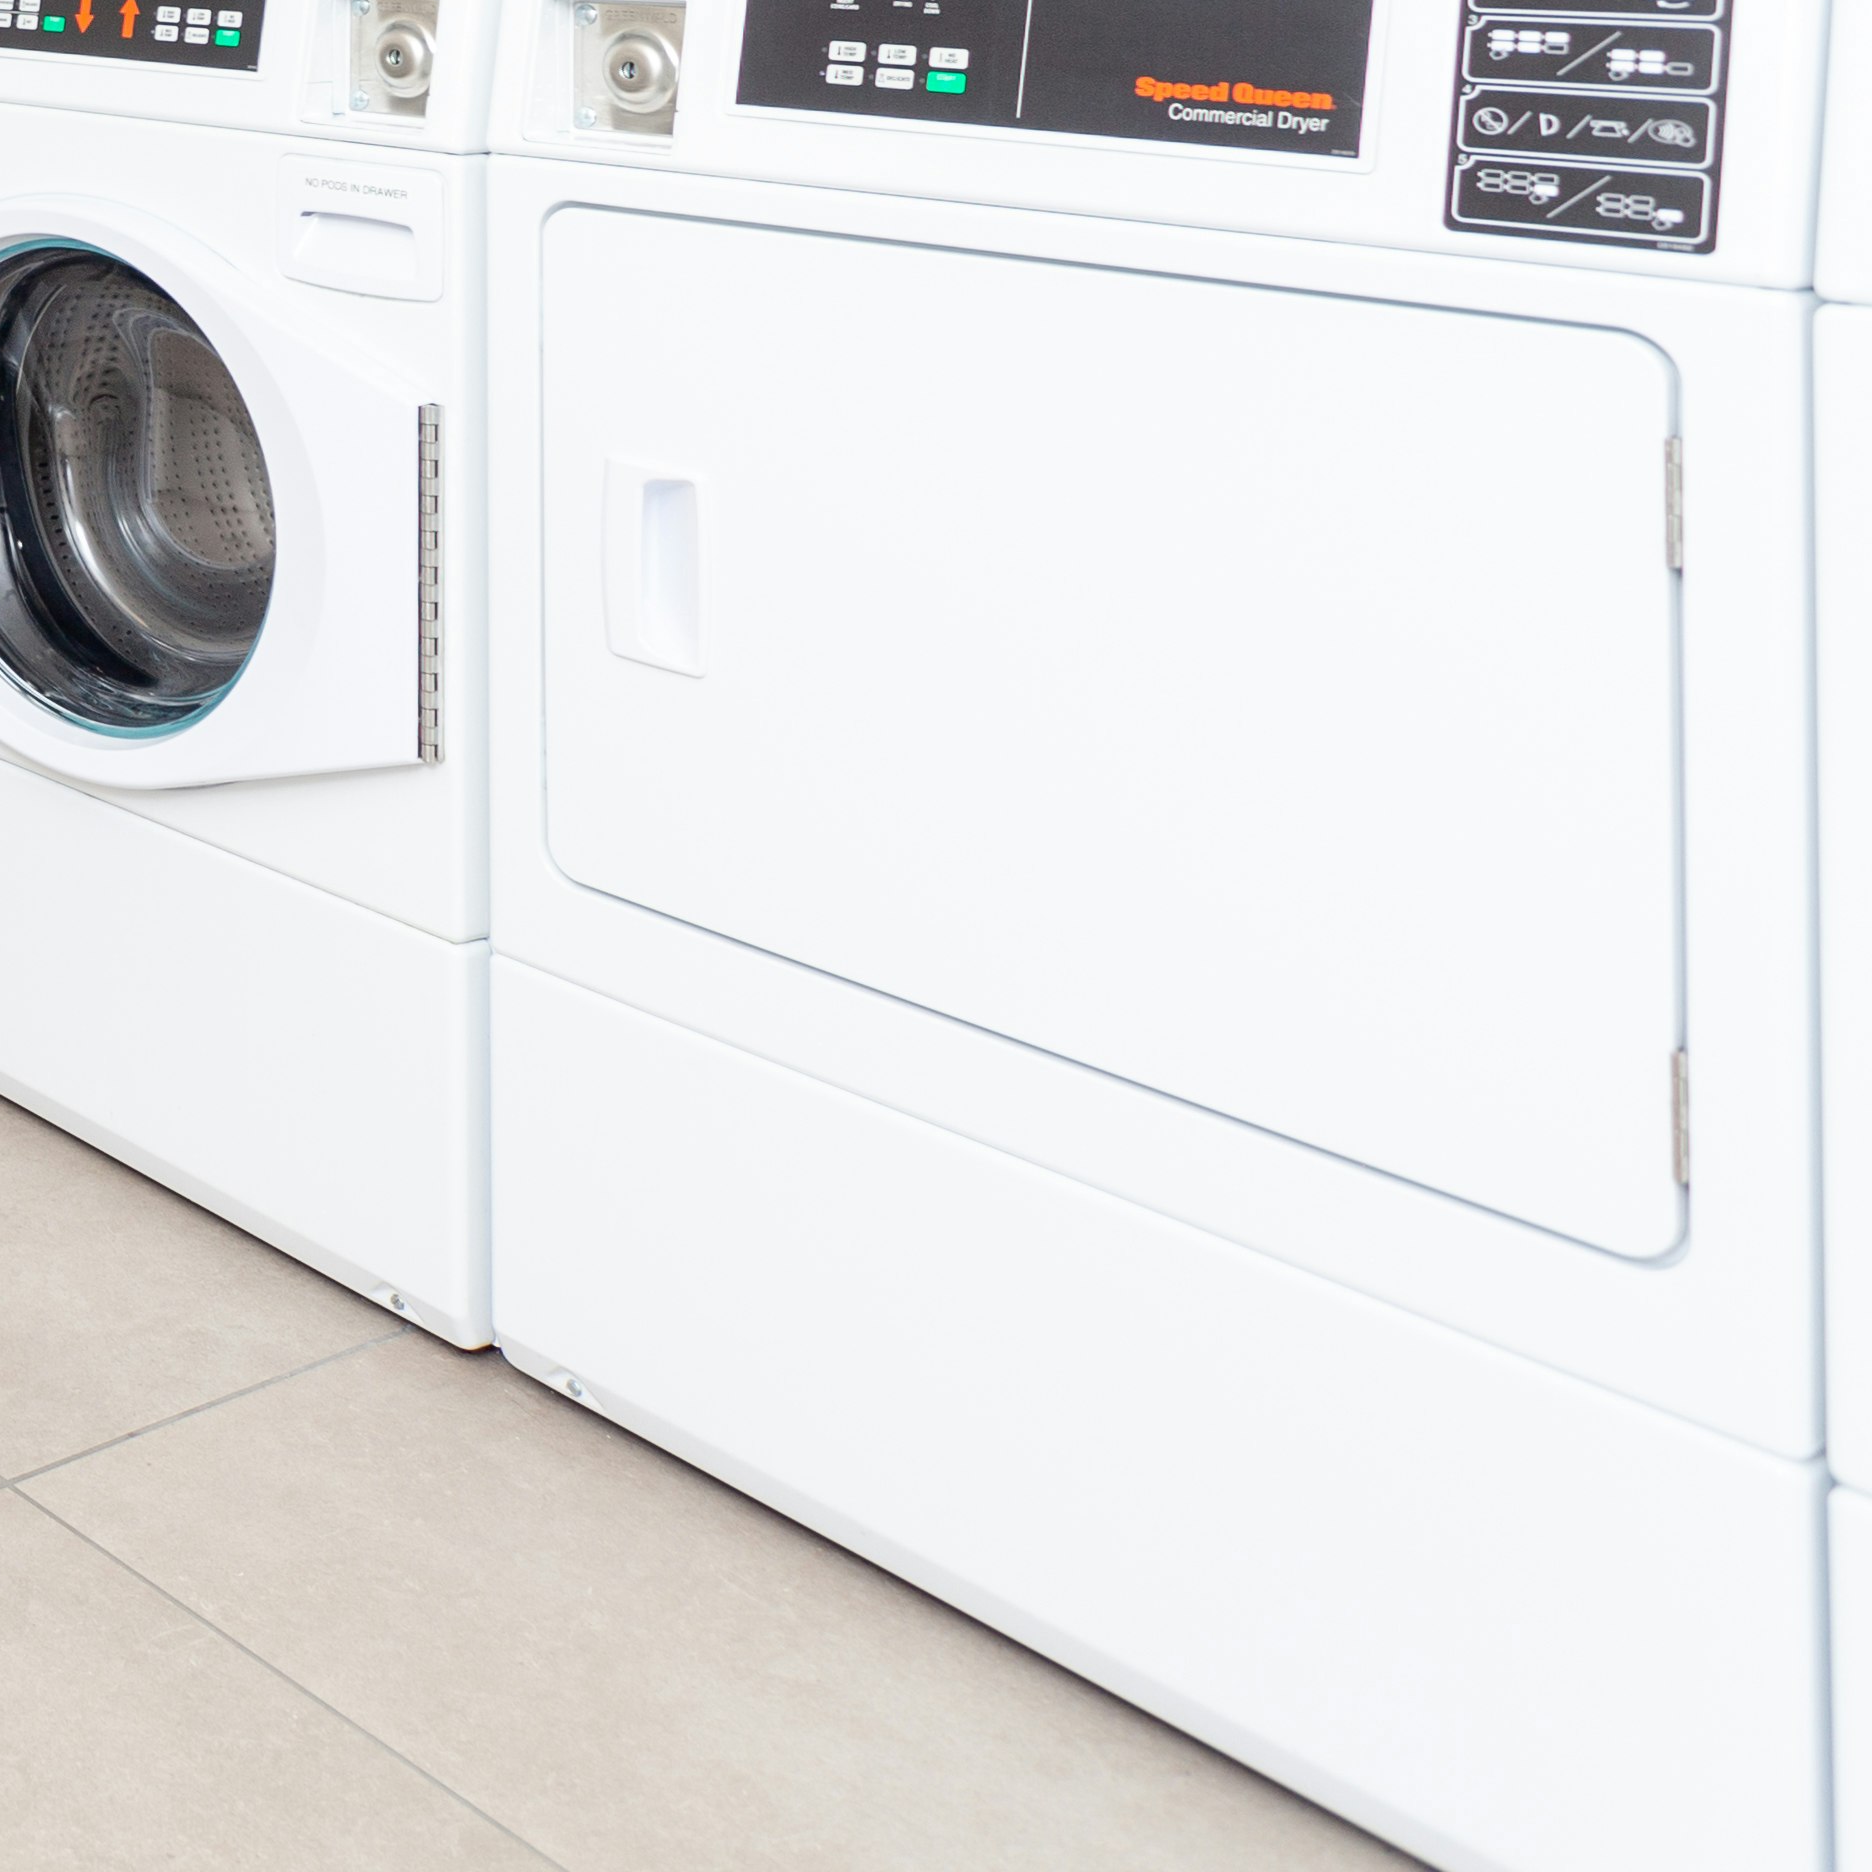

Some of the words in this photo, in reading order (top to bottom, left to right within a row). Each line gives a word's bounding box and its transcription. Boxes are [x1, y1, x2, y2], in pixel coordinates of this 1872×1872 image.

[1134, 76, 1229, 102] Speed
[1232, 82, 1336, 110] Queen
[1168, 103, 1273, 128] Commercial
[1277, 111, 1329, 134] Dryer
[305, 178, 319, 188] NO
[321, 179, 348, 192] PODS
[351, 184, 360, 193] IN
[363, 185, 408, 199] DRAWER
